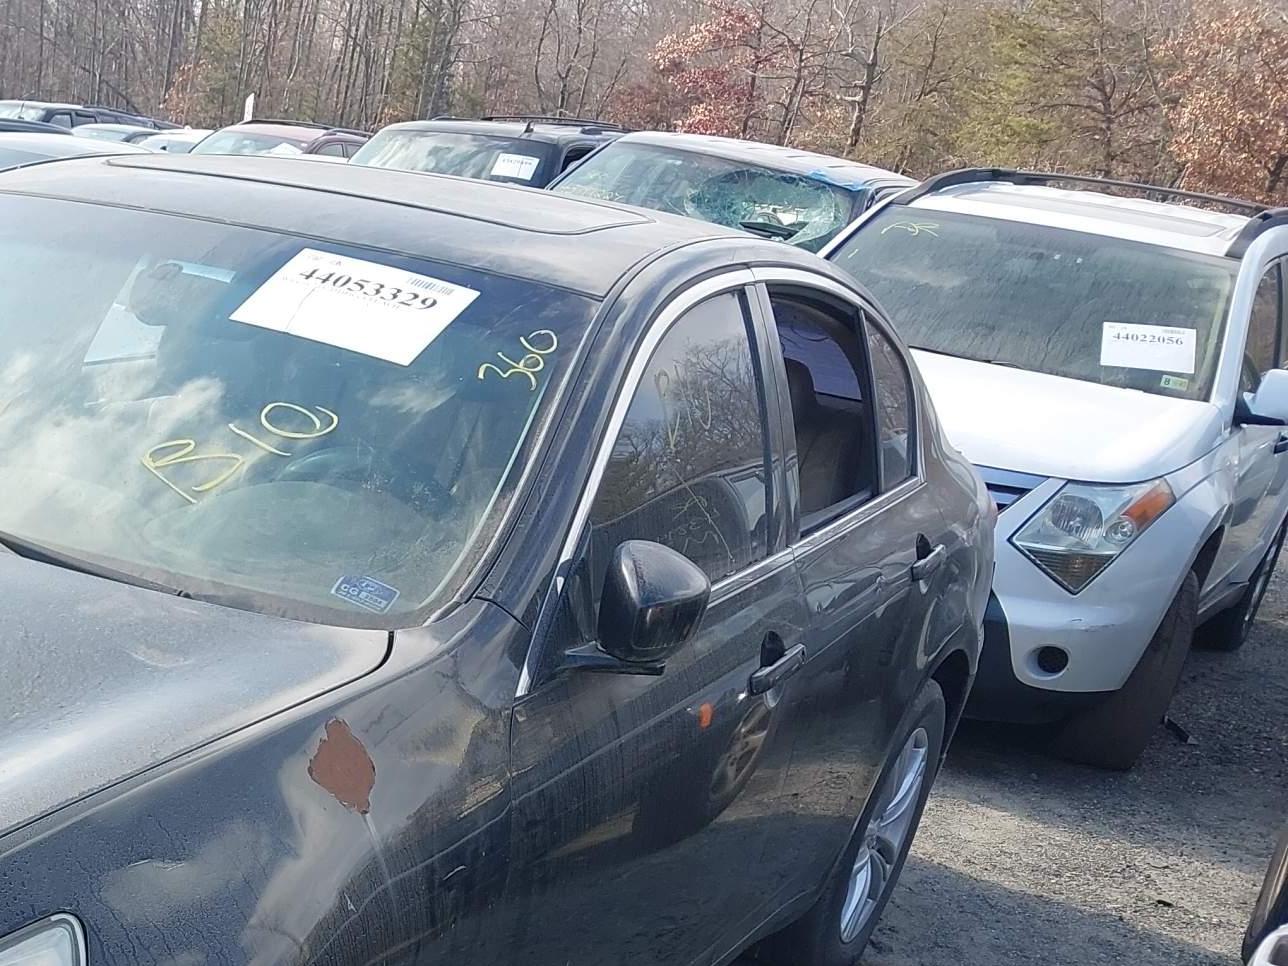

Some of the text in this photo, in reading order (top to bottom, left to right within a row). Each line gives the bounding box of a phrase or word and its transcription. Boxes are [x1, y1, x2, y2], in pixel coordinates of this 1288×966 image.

[299, 267, 438, 311] 44053329
[477, 329, 558, 391] 360
[1113, 332, 1184, 346] 44022056
[141, 402, 339, 504] B10
